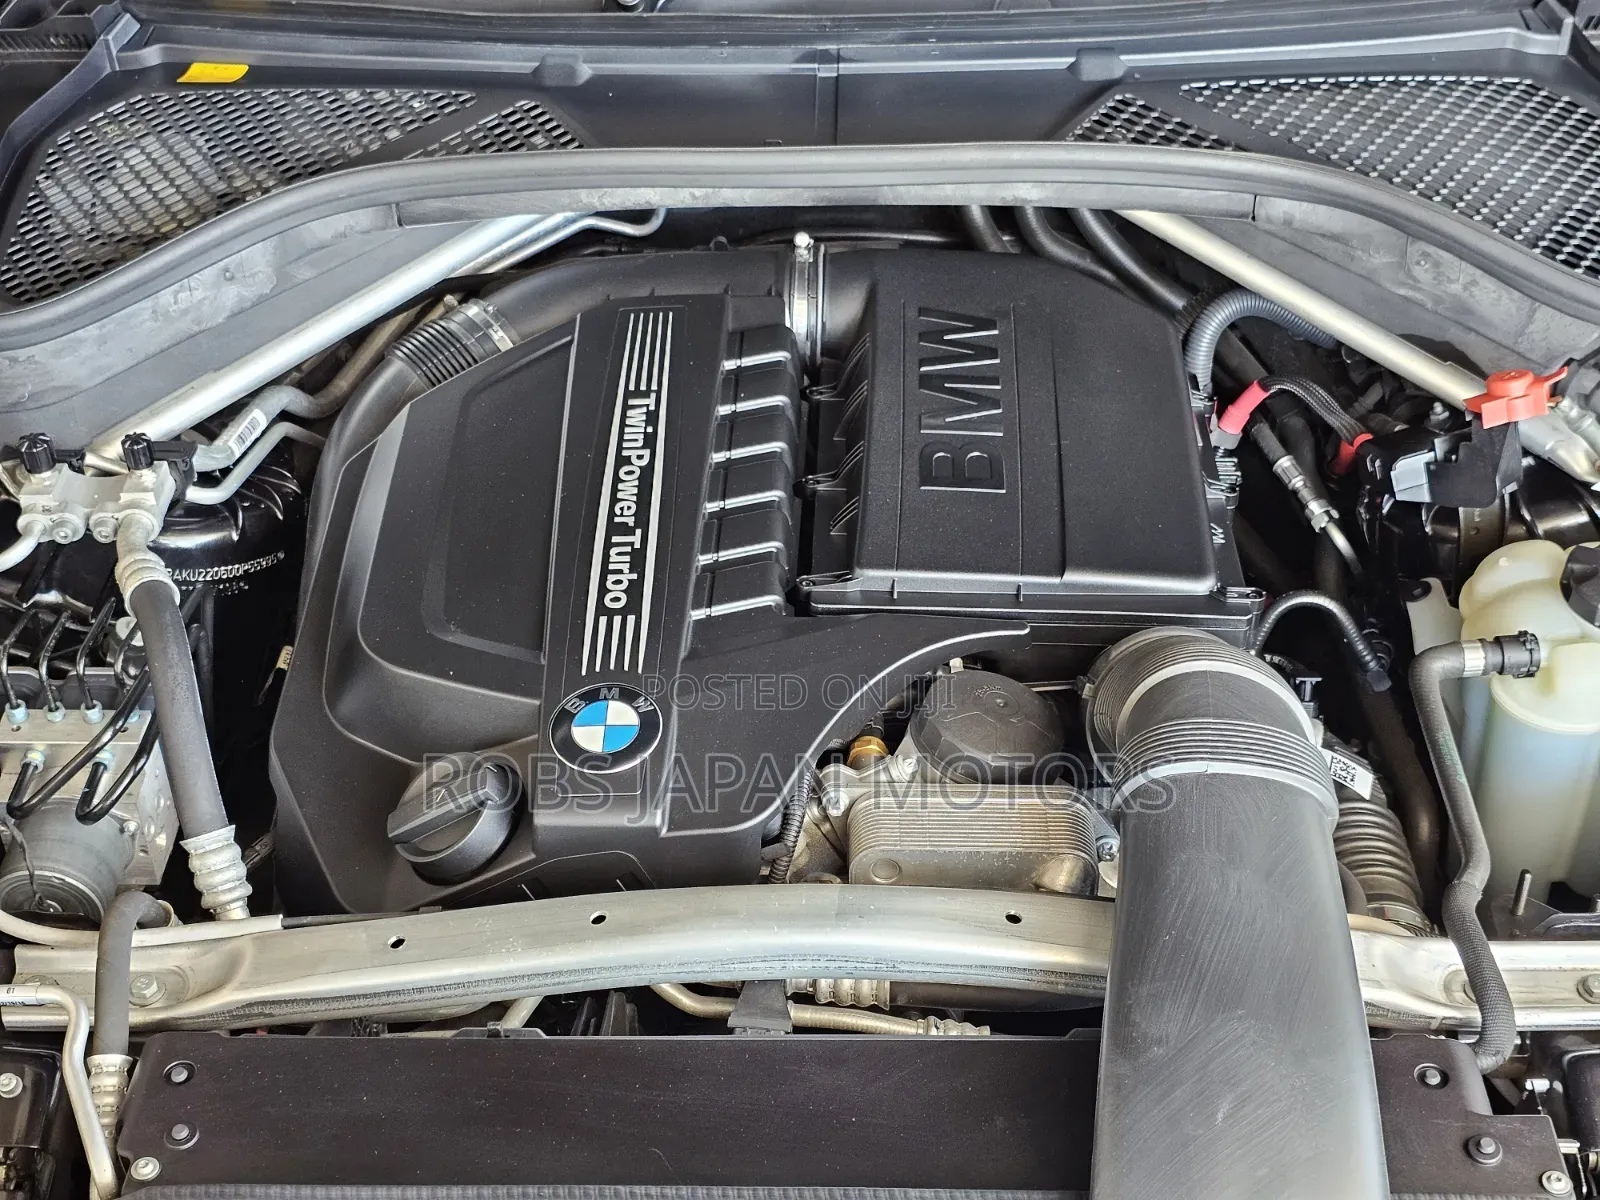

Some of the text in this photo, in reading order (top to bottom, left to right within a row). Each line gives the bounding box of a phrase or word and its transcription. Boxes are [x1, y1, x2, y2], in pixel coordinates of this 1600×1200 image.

[918, 307, 1006, 493] BMW
[603, 391, 656, 609] TwinPower Turbo
[563, 687, 655, 714] BMW
